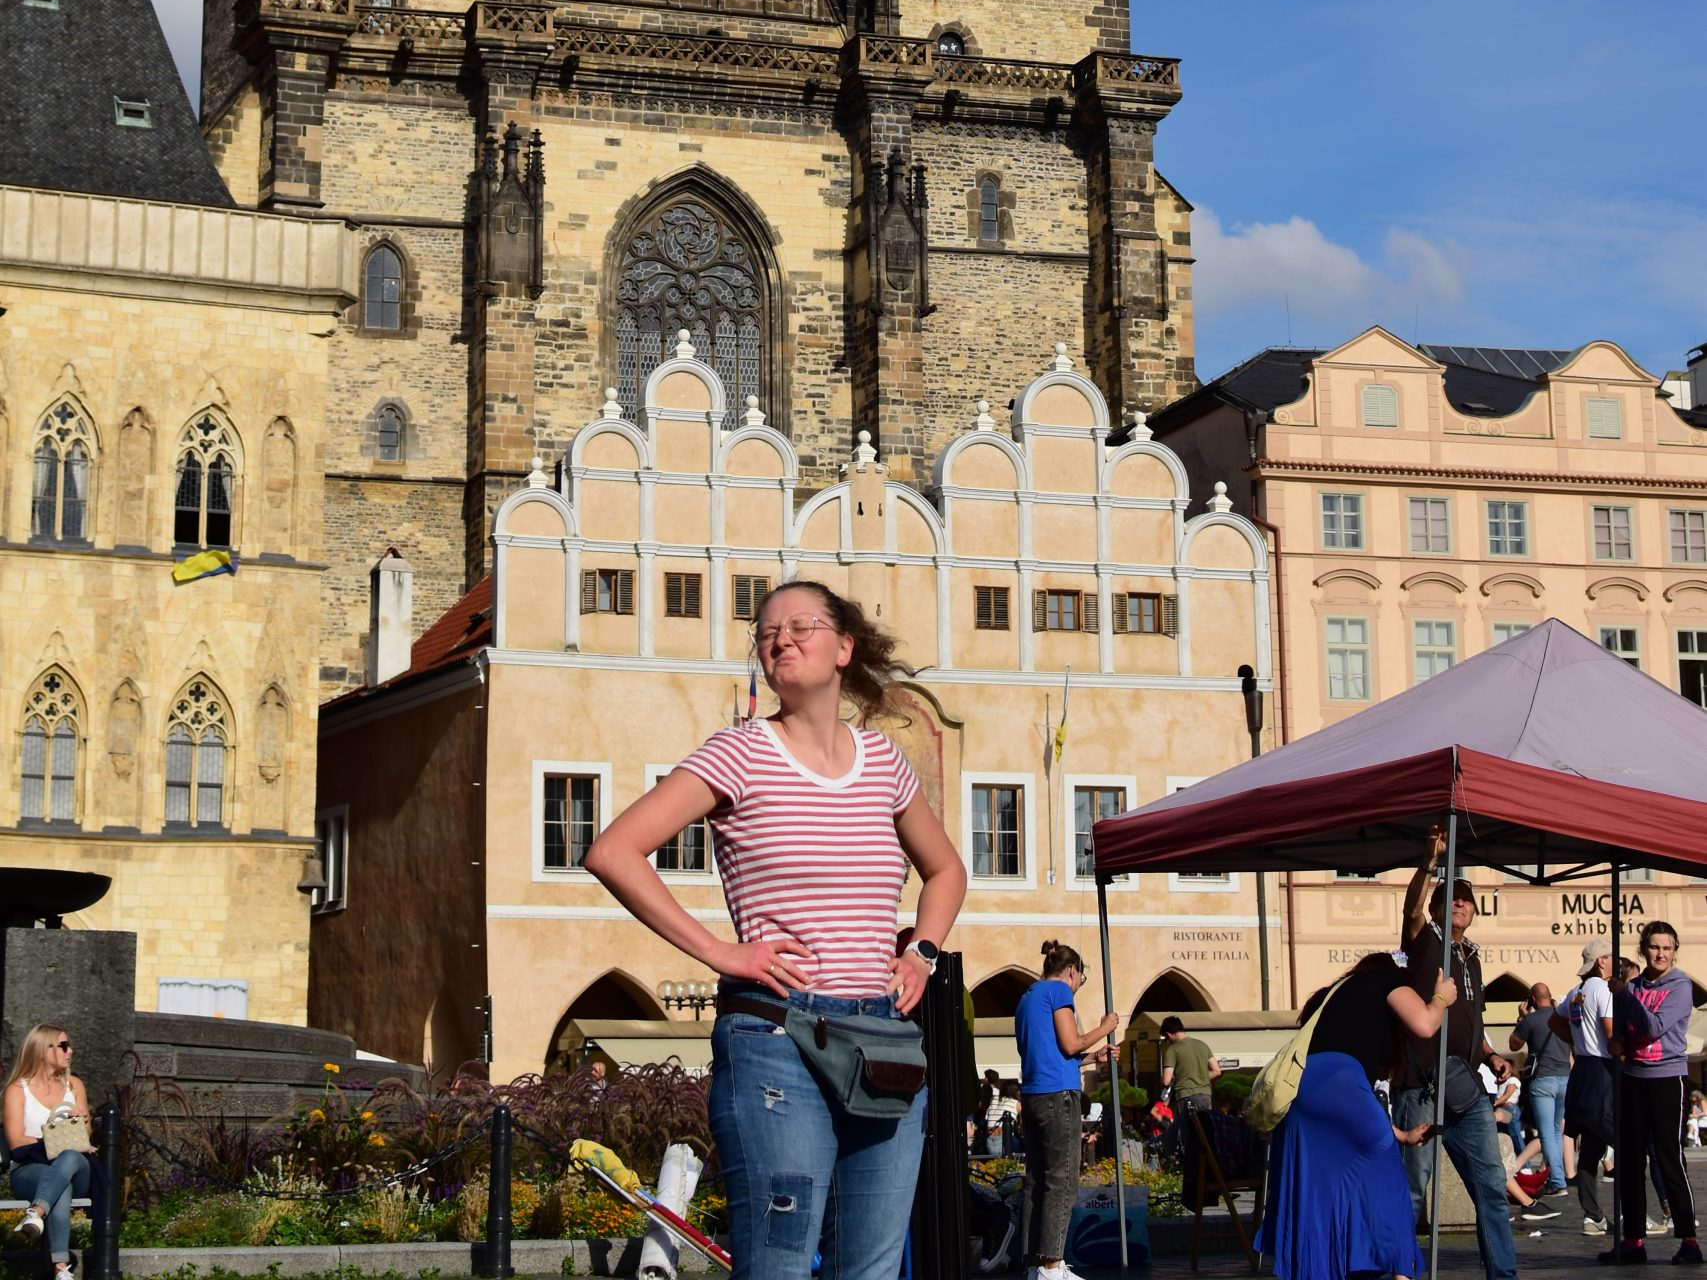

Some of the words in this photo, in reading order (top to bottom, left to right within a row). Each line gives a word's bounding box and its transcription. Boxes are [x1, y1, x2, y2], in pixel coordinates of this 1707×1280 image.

[1562, 893, 1645, 915] MUCHA
[1173, 931, 1243, 941] RISTORANTE
[1171, 950, 1208, 961] CAFFE
[1212, 950, 1250, 961] ITALIA
[1515, 946, 1560, 965] TÝNA
[1085, 1199, 1115, 1209] albert
